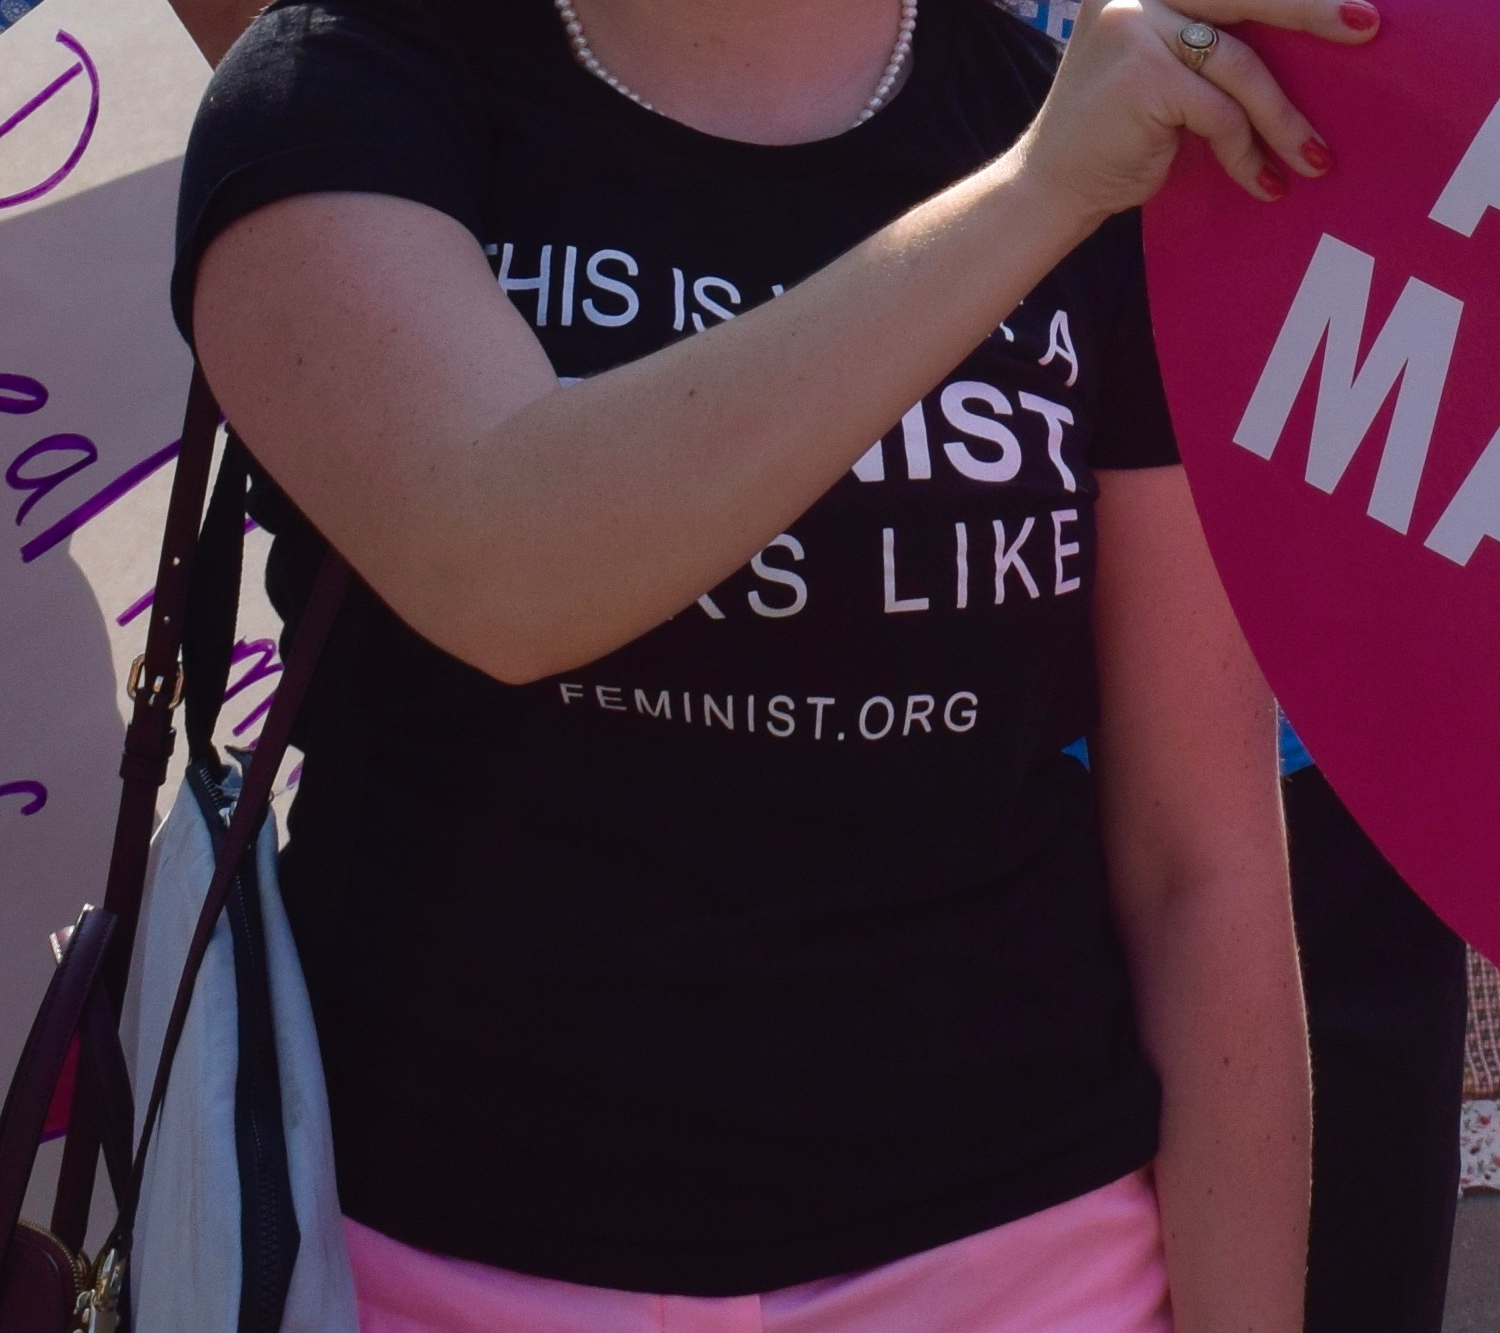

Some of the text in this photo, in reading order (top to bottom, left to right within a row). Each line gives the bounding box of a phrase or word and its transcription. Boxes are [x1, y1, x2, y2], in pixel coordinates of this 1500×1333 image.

[1038, 308, 1080, 388] A
[881, 508, 1082, 615] LIKE
[560, 681, 980, 742] FEMINIST.ORG
